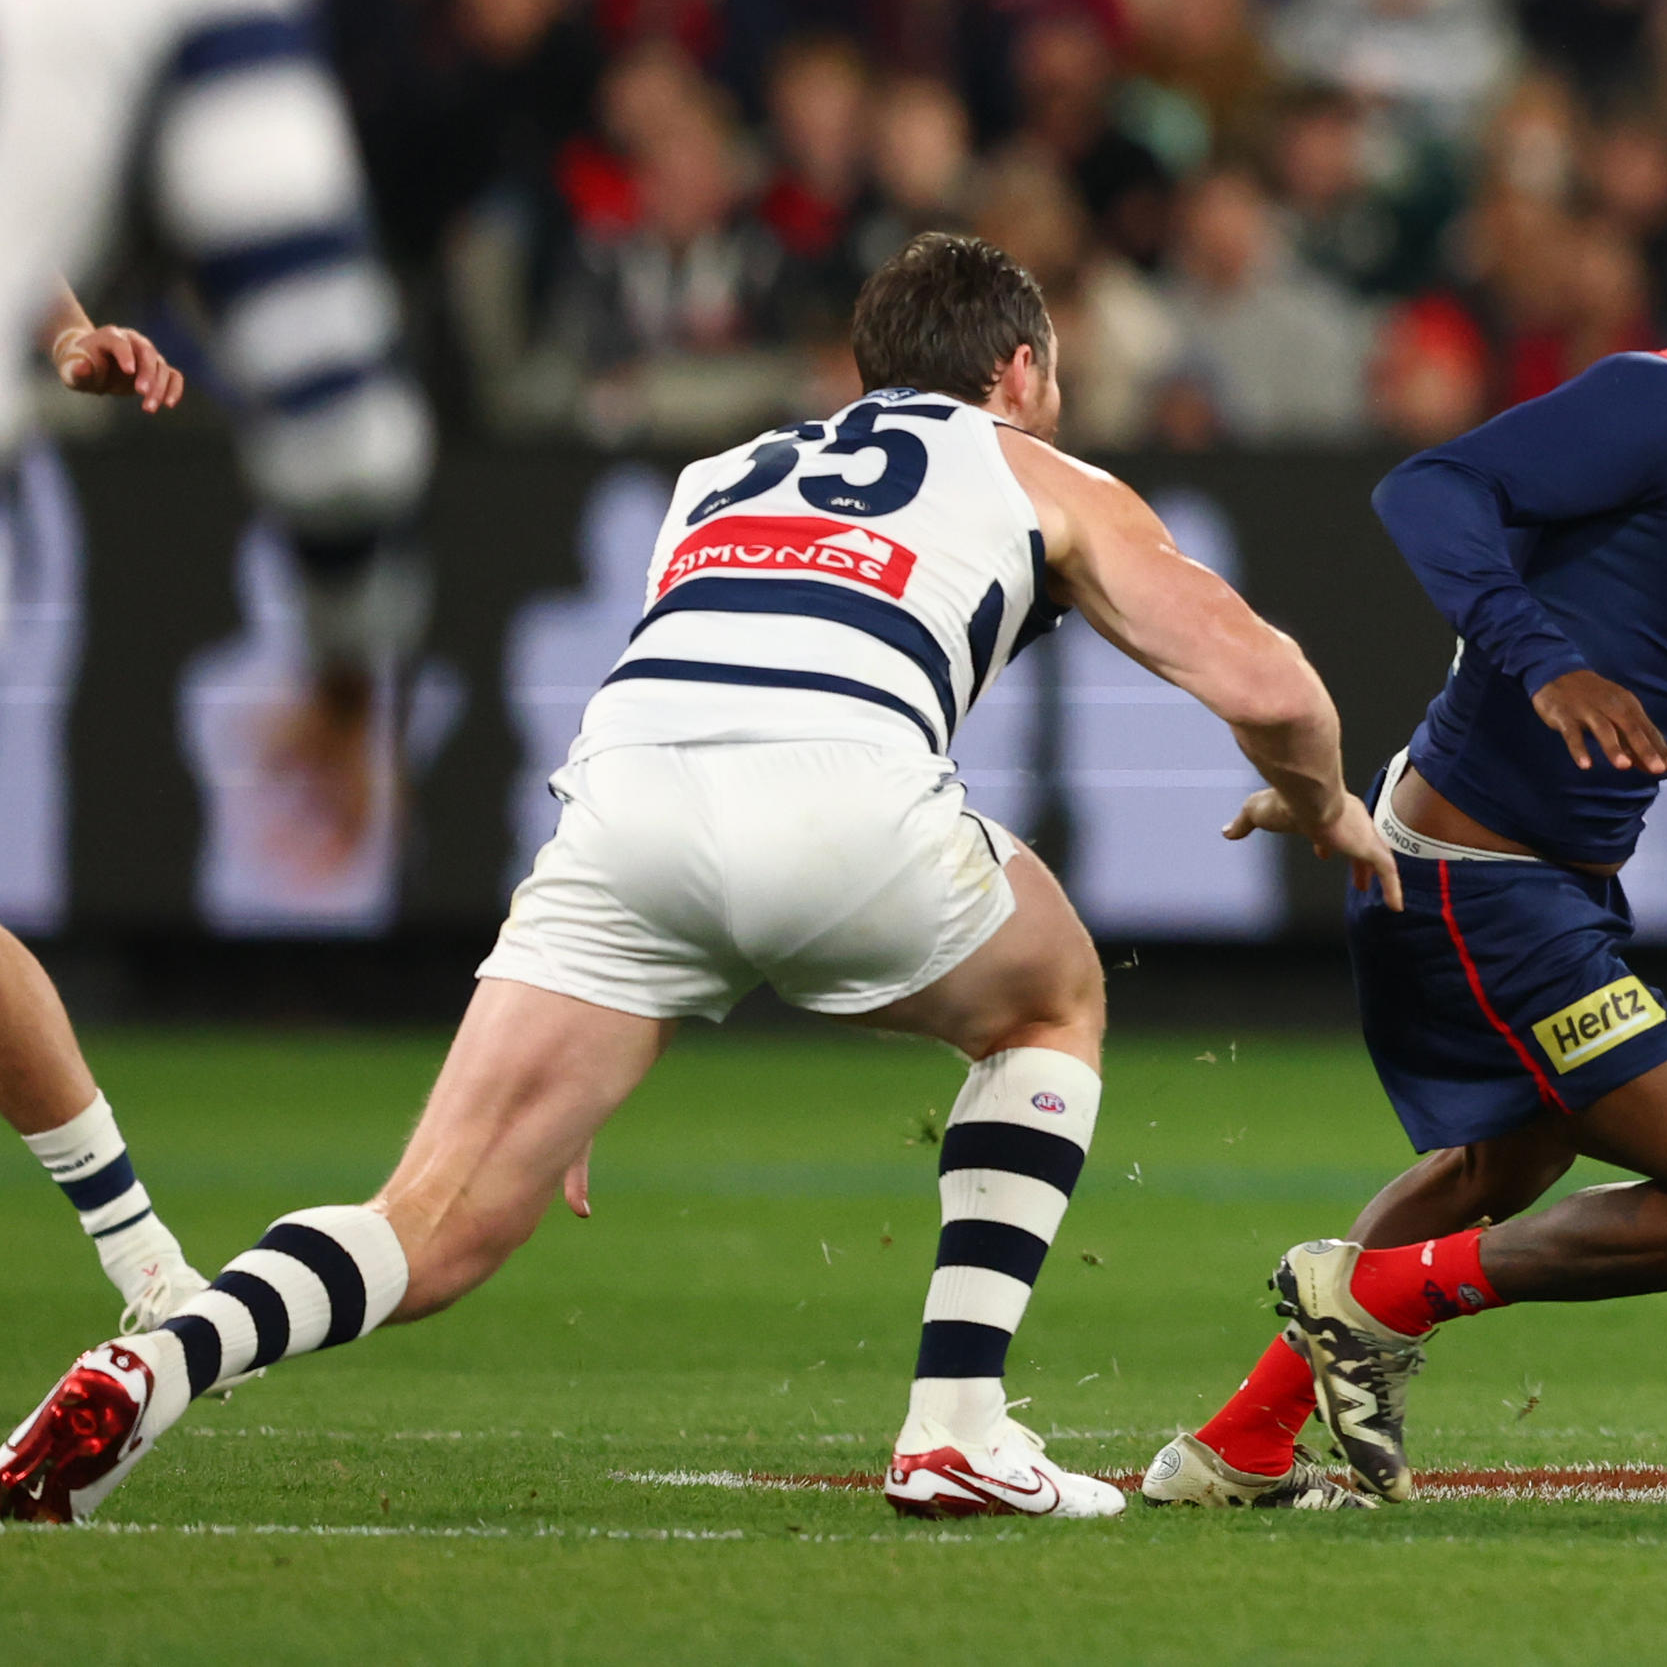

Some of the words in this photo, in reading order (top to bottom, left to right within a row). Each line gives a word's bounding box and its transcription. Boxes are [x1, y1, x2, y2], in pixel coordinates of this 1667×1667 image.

[669, 544, 884, 585] SIMONDS
[1381, 818, 1421, 855] BONDS
[1551, 987, 1647, 1054] Hertz
